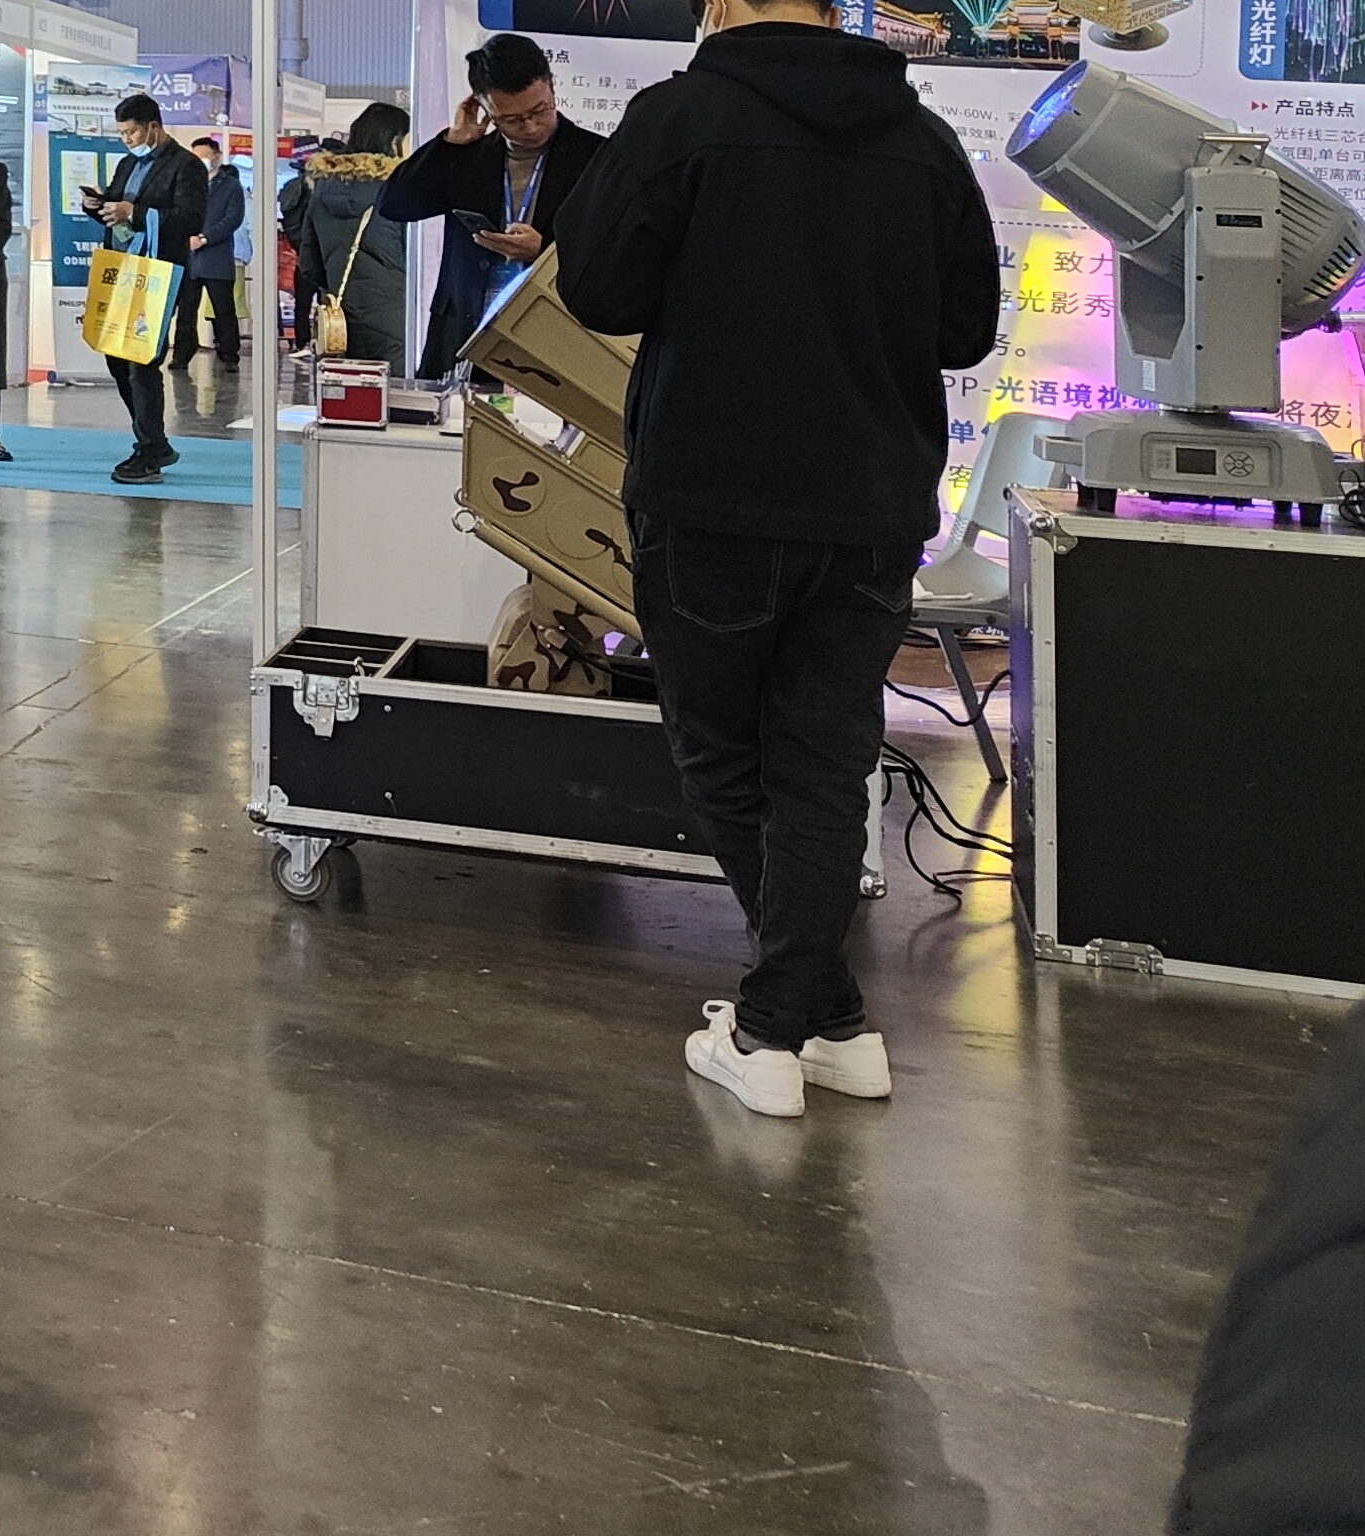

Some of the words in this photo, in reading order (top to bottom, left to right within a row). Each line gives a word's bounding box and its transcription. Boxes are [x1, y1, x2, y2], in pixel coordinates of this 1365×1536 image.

[152, 74, 194, 96] 公司
[1275, 100, 1355, 118] 产品特点
